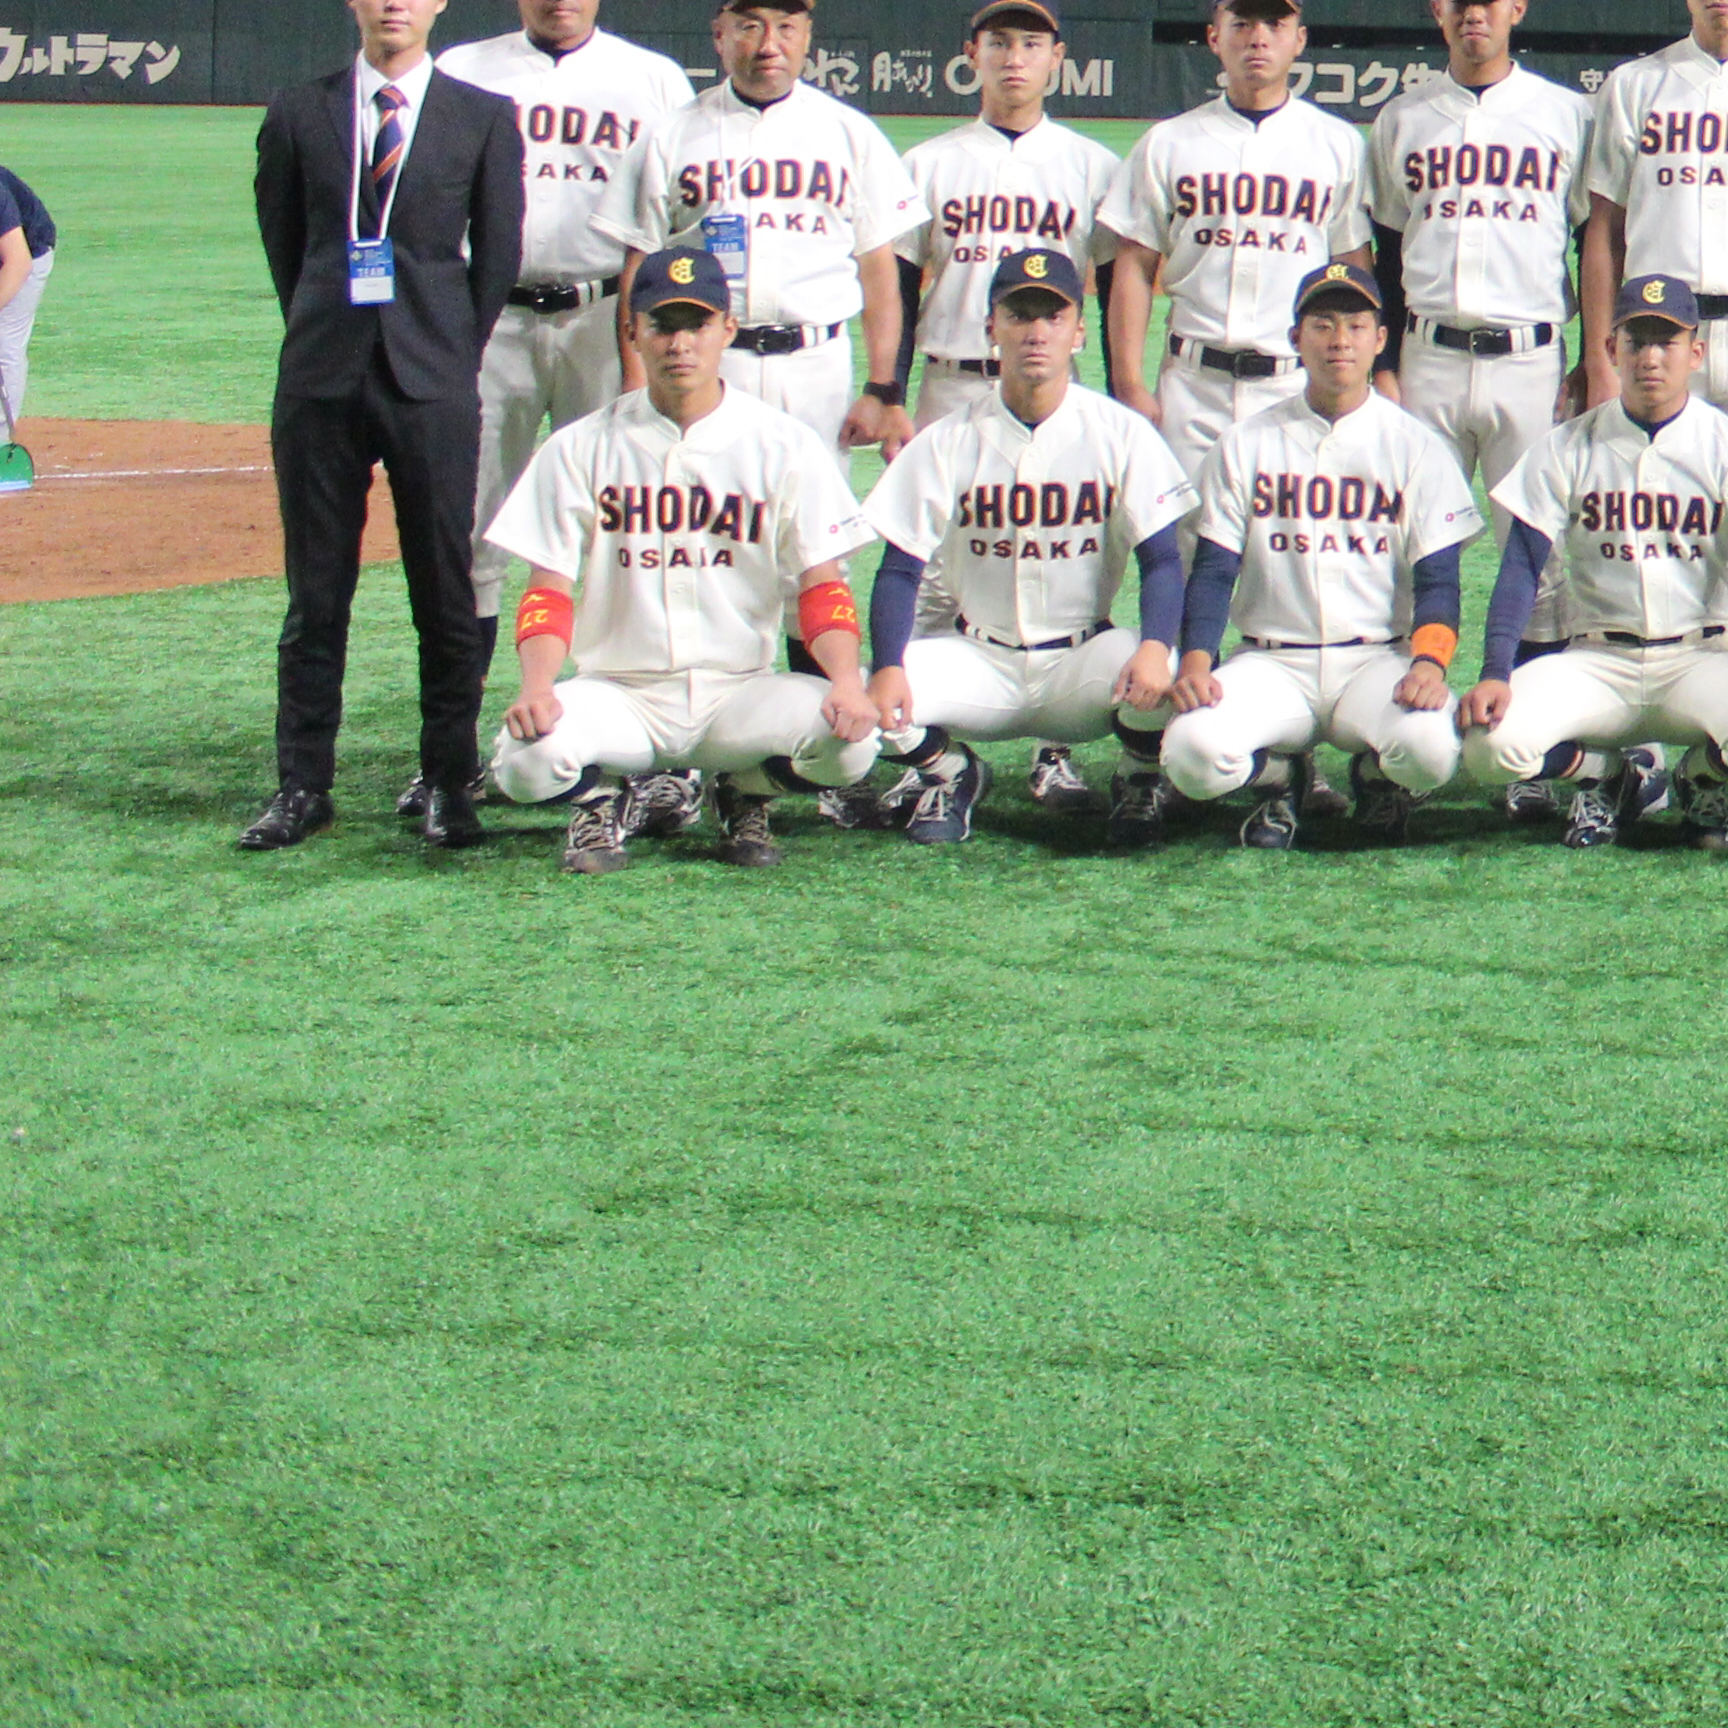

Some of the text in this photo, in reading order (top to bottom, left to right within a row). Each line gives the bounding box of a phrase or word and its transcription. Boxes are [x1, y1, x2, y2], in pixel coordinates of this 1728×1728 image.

[678, 156, 849, 209] SHODAI
[1404, 144, 1560, 194] SHODAI
[942, 194, 1076, 241] SHODAI
[1175, 171, 1334, 226] SHODAI
[1194, 228, 1309, 255] OSAKA
[598, 484, 767, 545] SHODAI
[957, 480, 1115, 530] SHODAI
[1580, 490, 1723, 537] SHODAI
[968, 537, 1099, 561] OSAKA
[1268, 531, 1390, 556] OSAKA
[1600, 540, 1705, 561] OSAKA
